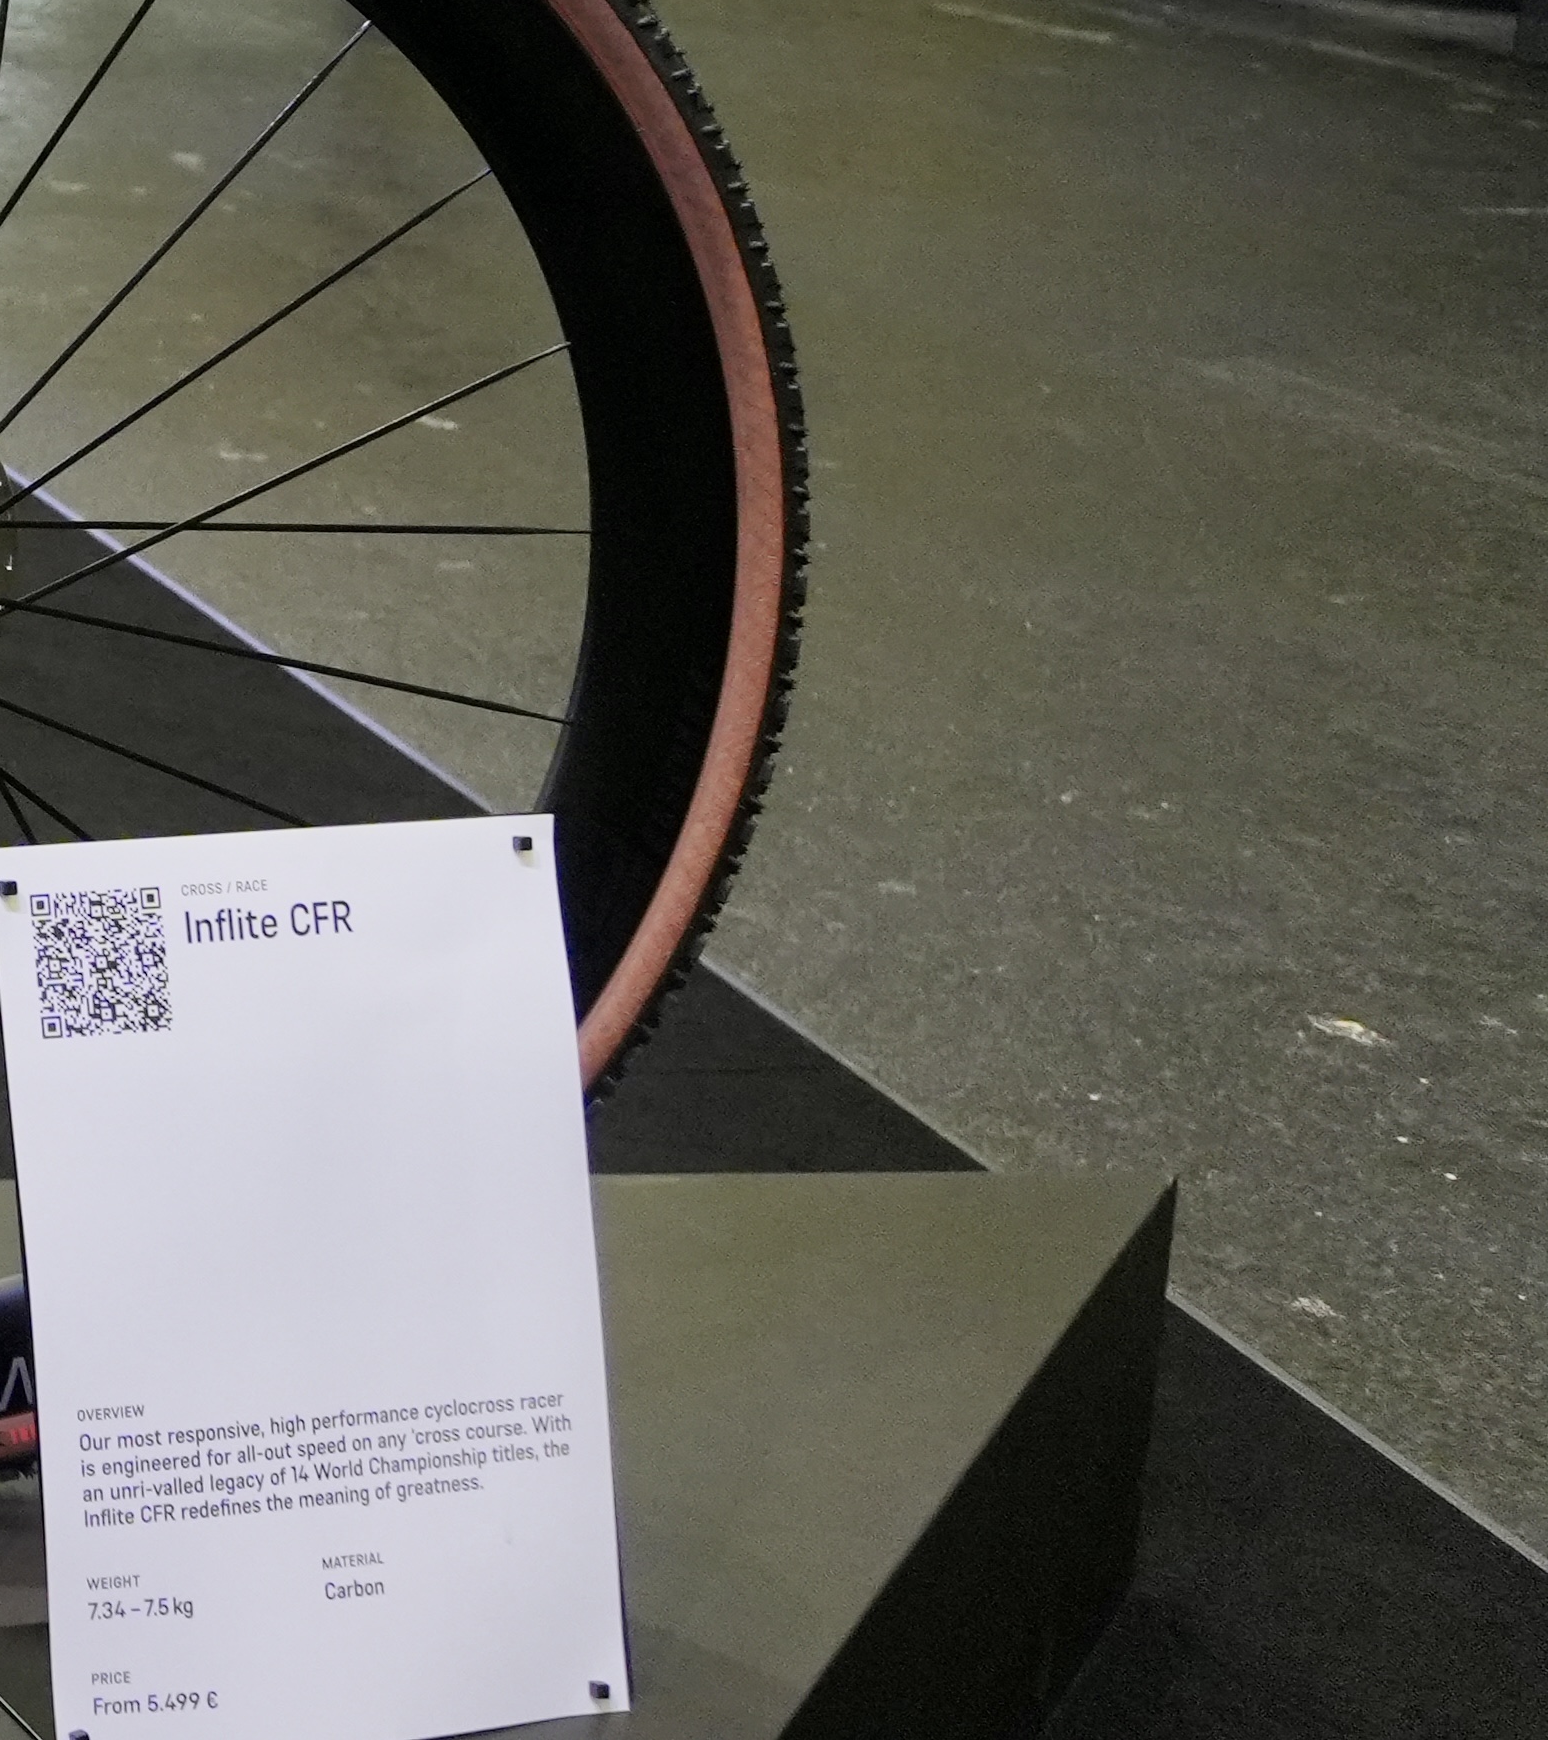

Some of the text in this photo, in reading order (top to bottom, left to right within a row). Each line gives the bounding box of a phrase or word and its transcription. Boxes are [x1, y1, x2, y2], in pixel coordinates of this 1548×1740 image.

[181, 883, 222, 896] CROSS
[236, 880, 267, 892] RACE
[185, 900, 354, 944] Inflite CFR
[77, 1405, 144, 1422] OVERVIEW
[80, 1395, 563, 1451] Our most responsive, high performance cyclocross racer
[81, 1414, 571, 1478] is engineered for all-out speed on any 'cross course. With
[83, 1440, 569, 1502] an unri-valled legacy of 14 World Championship titles, the
[84, 1477, 483, 1527] Inflite CFR redefines the meaning of greatness.
[322, 1553, 384, 1569] MATERIAL
[87, 1575, 140, 1590] WEIGHT
[325, 1580, 384, 1600] Carbon
[88, 1601, 126, 1620] 7.34
[144, 1598, 169, 1616] 7.5
[173, 1597, 193, 1619] kg
[92, 1671, 130, 1684] PRICE
[93, 1691, 218, 1715] From 5.499 €
